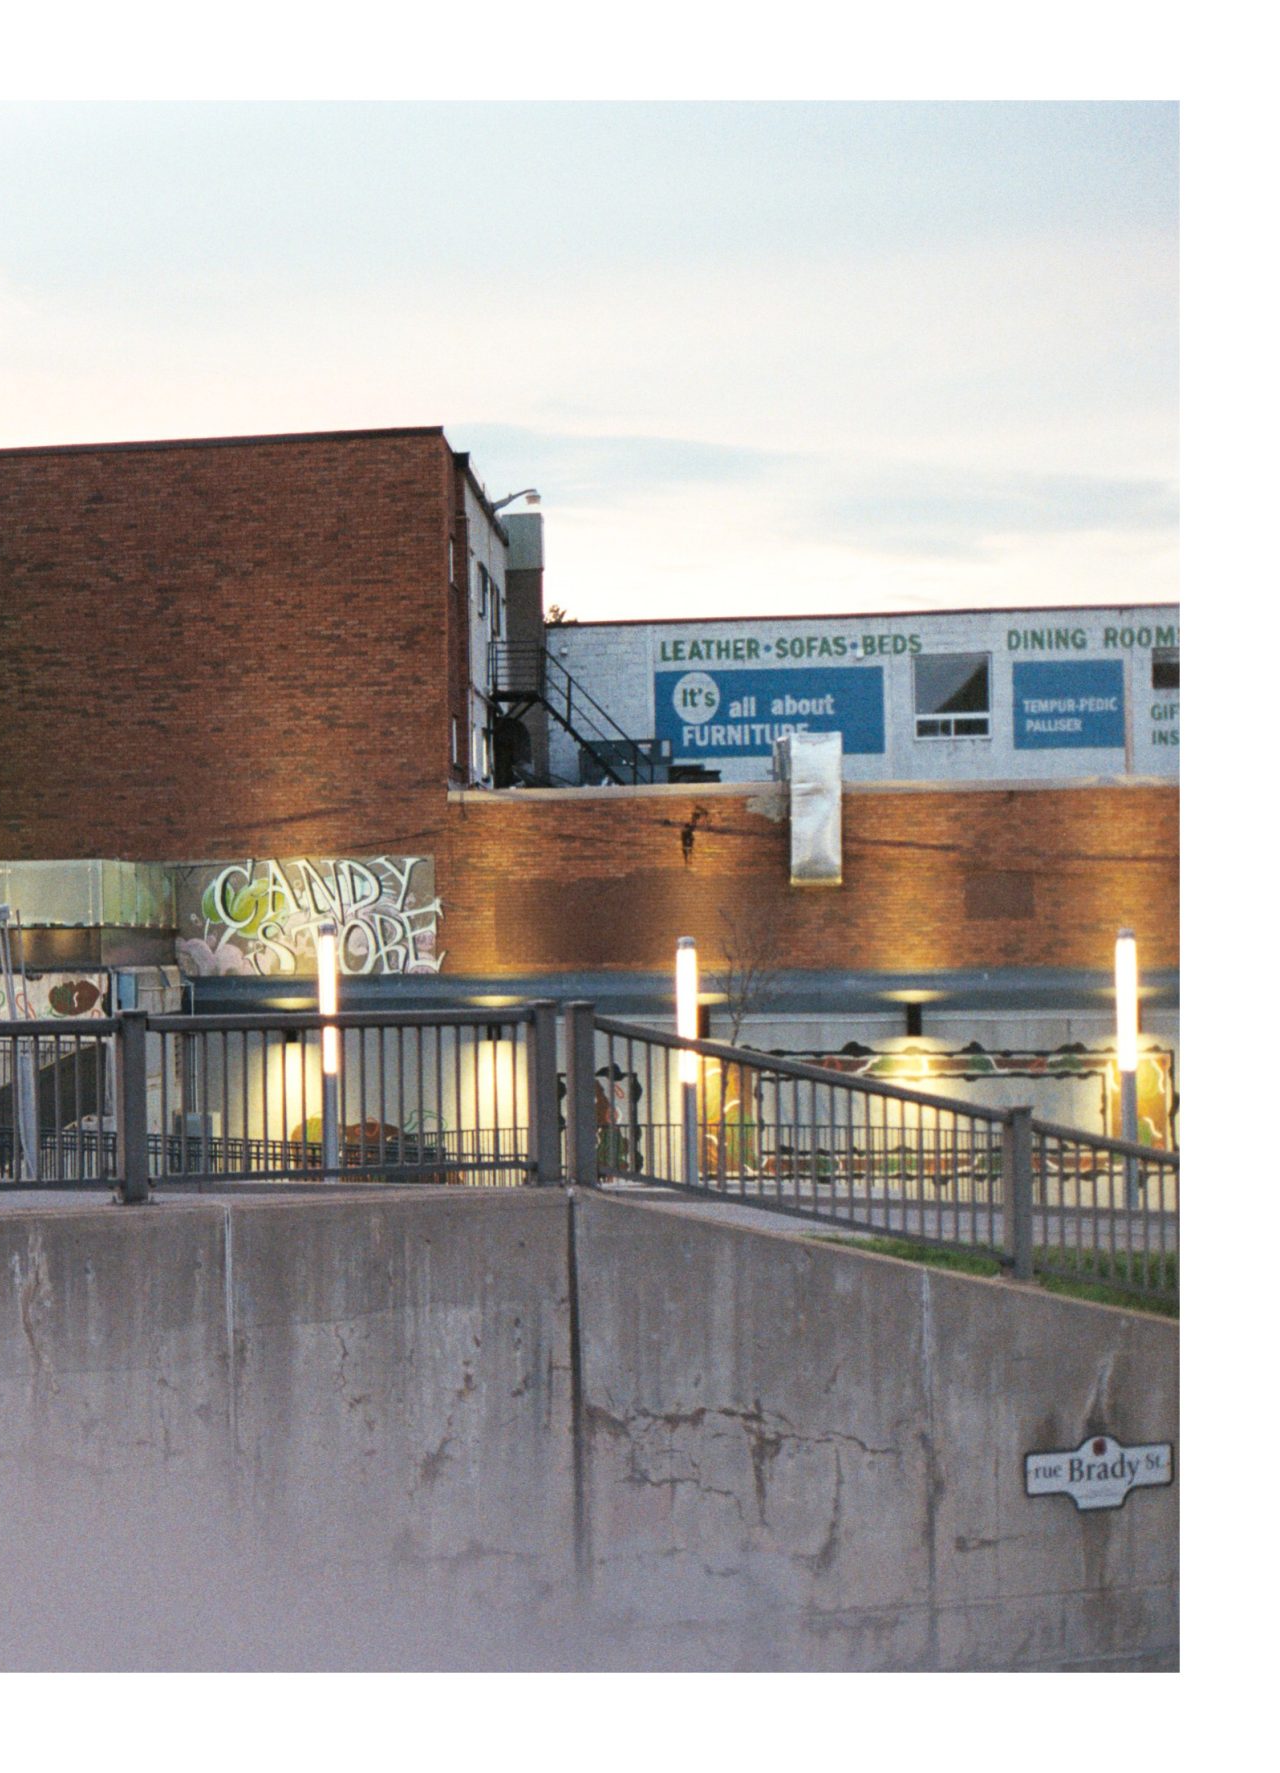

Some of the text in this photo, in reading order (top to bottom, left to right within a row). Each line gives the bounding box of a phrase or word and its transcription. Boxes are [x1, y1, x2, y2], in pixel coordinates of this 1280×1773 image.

[660, 634, 922, 662] LEATHER SOFAS BEDS
[1007, 626, 1180, 651] DINING ROOM
[681, 687, 716, 708] It's
[729, 694, 835, 718] all about
[1023, 697, 1118, 714] TEMPUR-PEDIC
[1026, 717, 1083, 733] PALLISER
[214, 855, 427, 928] CANDY
[244, 896, 447, 975] STORE
[1033, 1464, 1062, 1480] rue
[1068, 1452, 1139, 1486] Brady
